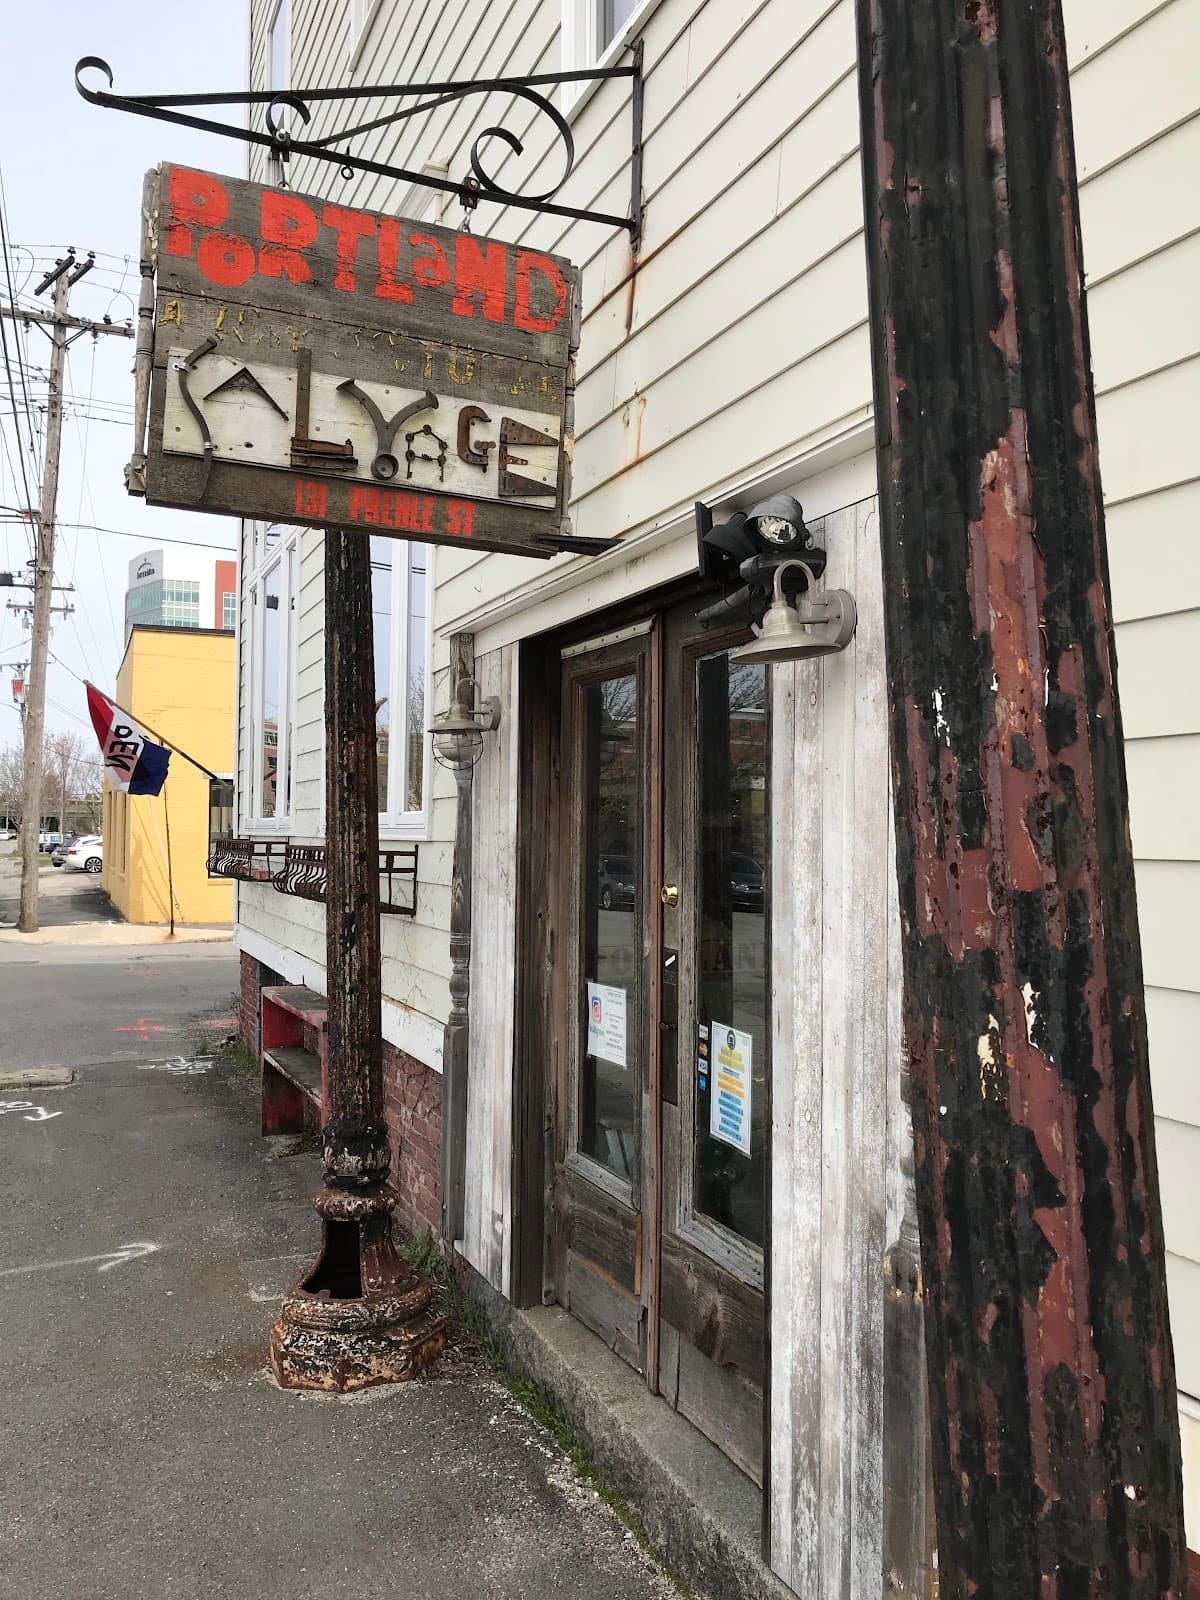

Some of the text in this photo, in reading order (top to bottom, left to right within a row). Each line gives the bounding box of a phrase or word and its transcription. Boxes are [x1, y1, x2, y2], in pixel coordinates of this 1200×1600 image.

[295, 480, 477, 537] 131 PREBLE ST
